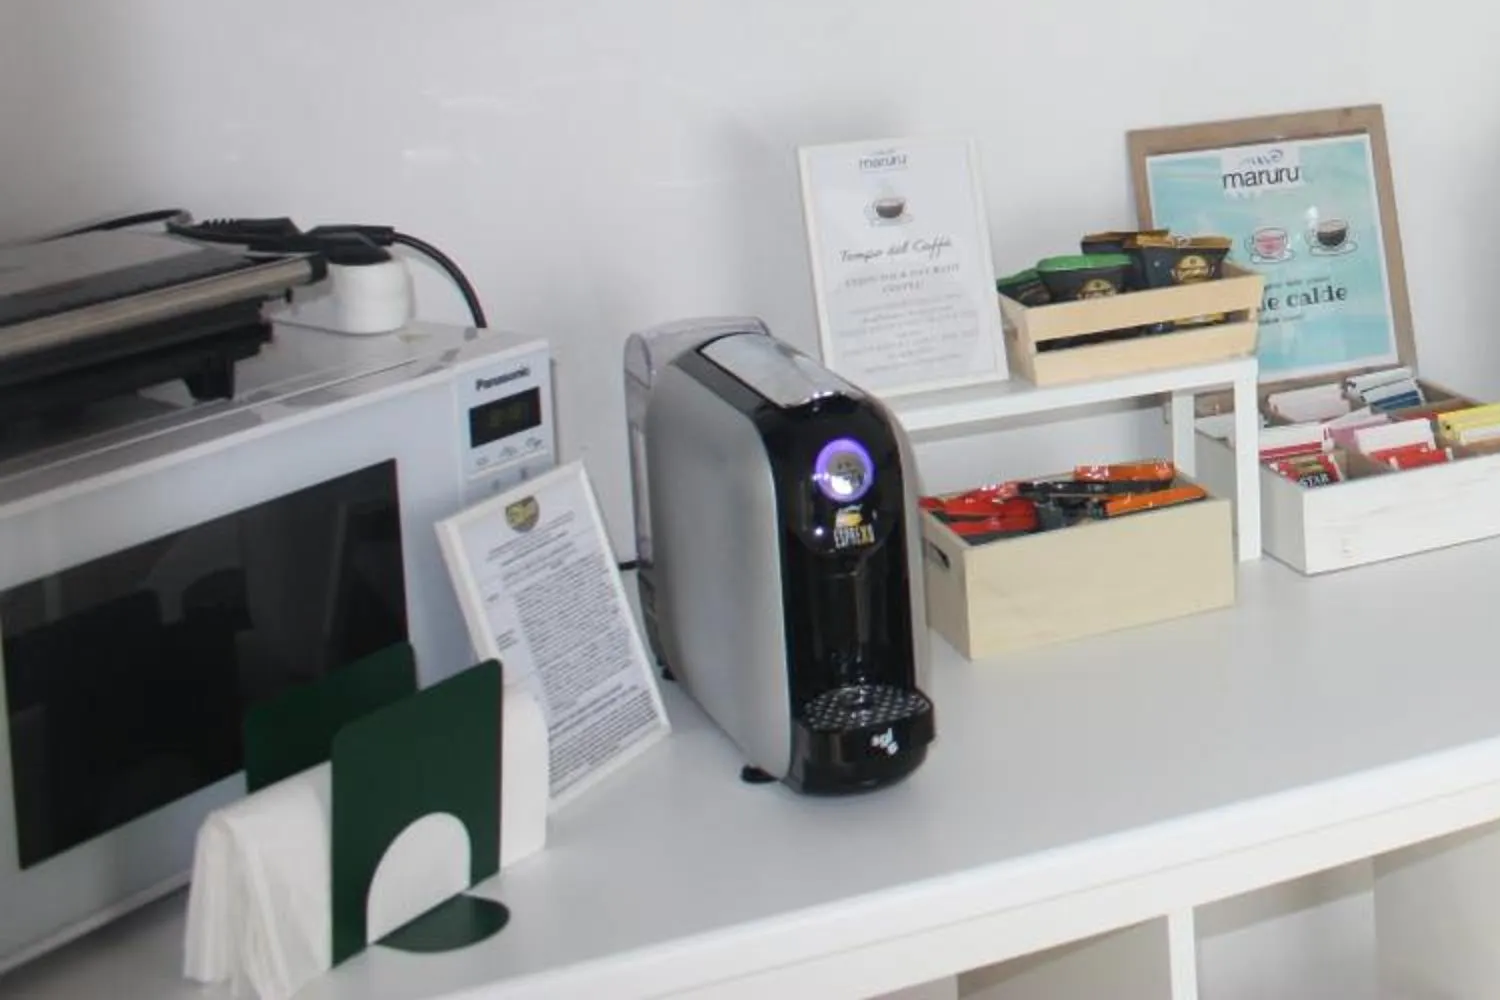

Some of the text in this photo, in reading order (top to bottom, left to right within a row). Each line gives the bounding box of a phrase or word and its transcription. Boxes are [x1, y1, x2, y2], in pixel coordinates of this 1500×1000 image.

[859, 154, 908, 171] maruru
[1223, 166, 1299, 189] maruru
[475, 366, 531, 391] Panasonic
